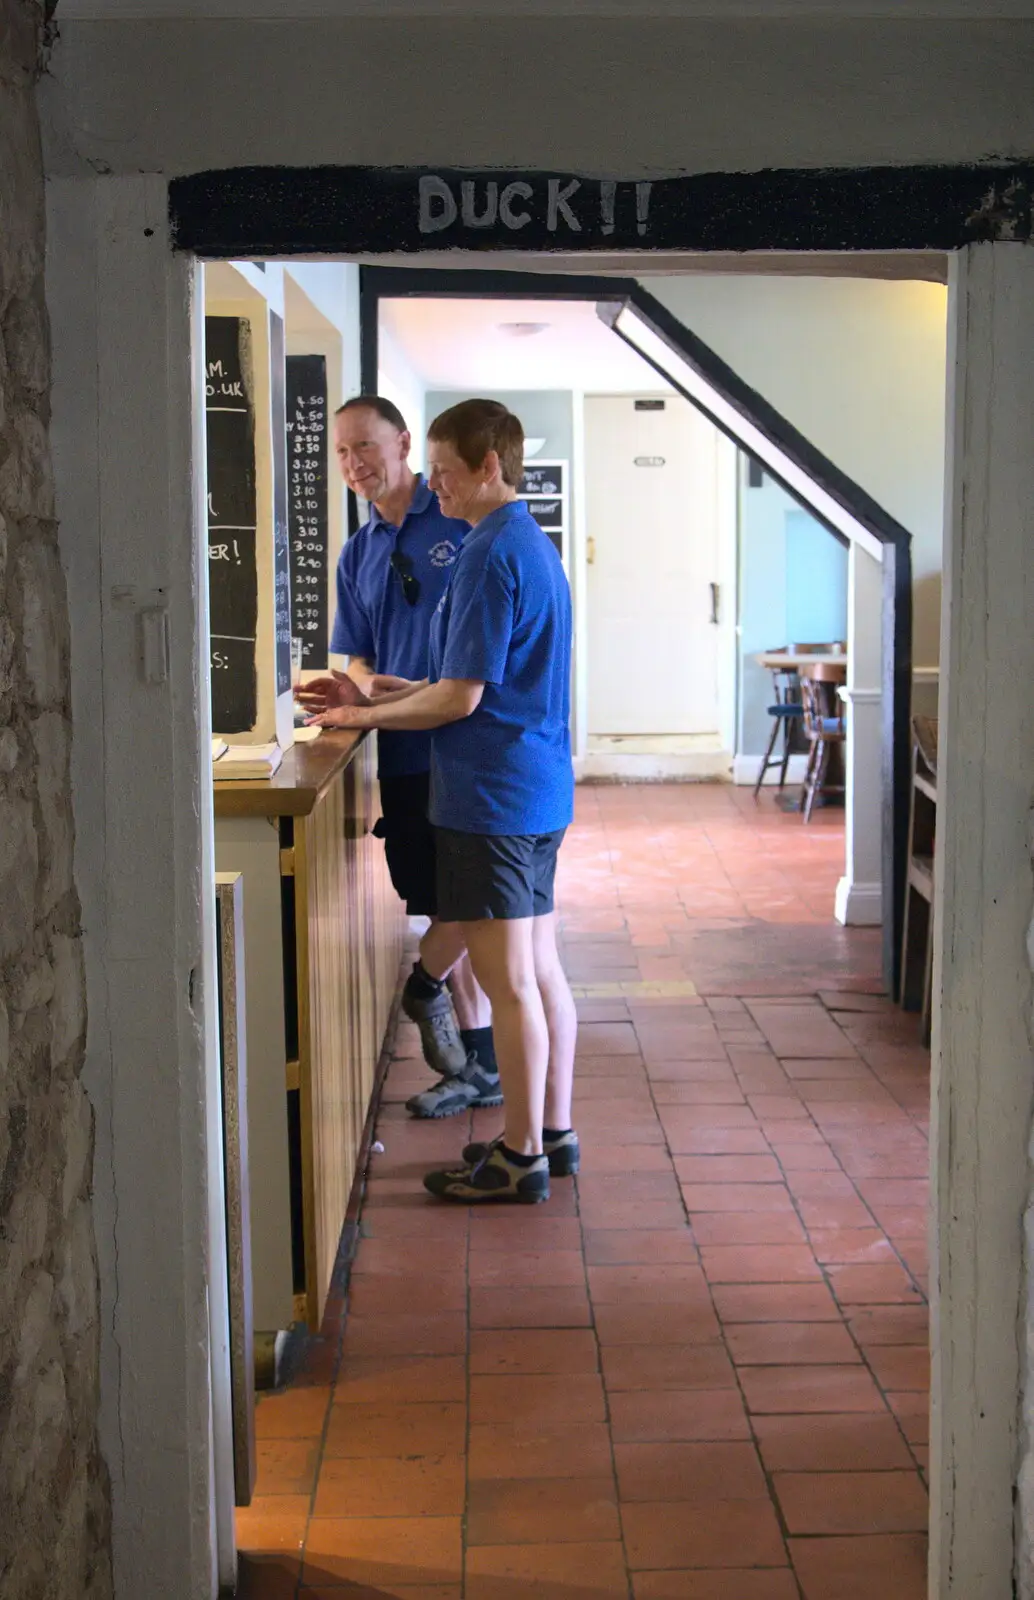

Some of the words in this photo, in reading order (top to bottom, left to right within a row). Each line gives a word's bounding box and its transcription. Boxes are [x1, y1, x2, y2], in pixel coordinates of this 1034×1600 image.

[292, 459, 319, 470] 3.20
[291, 472, 316, 483] 3.10
[293, 485, 316, 496] 3.10
[294, 500, 318, 510] 3.10
[293, 540, 324, 552] 3.00
[296, 555, 322, 569] 2.90
